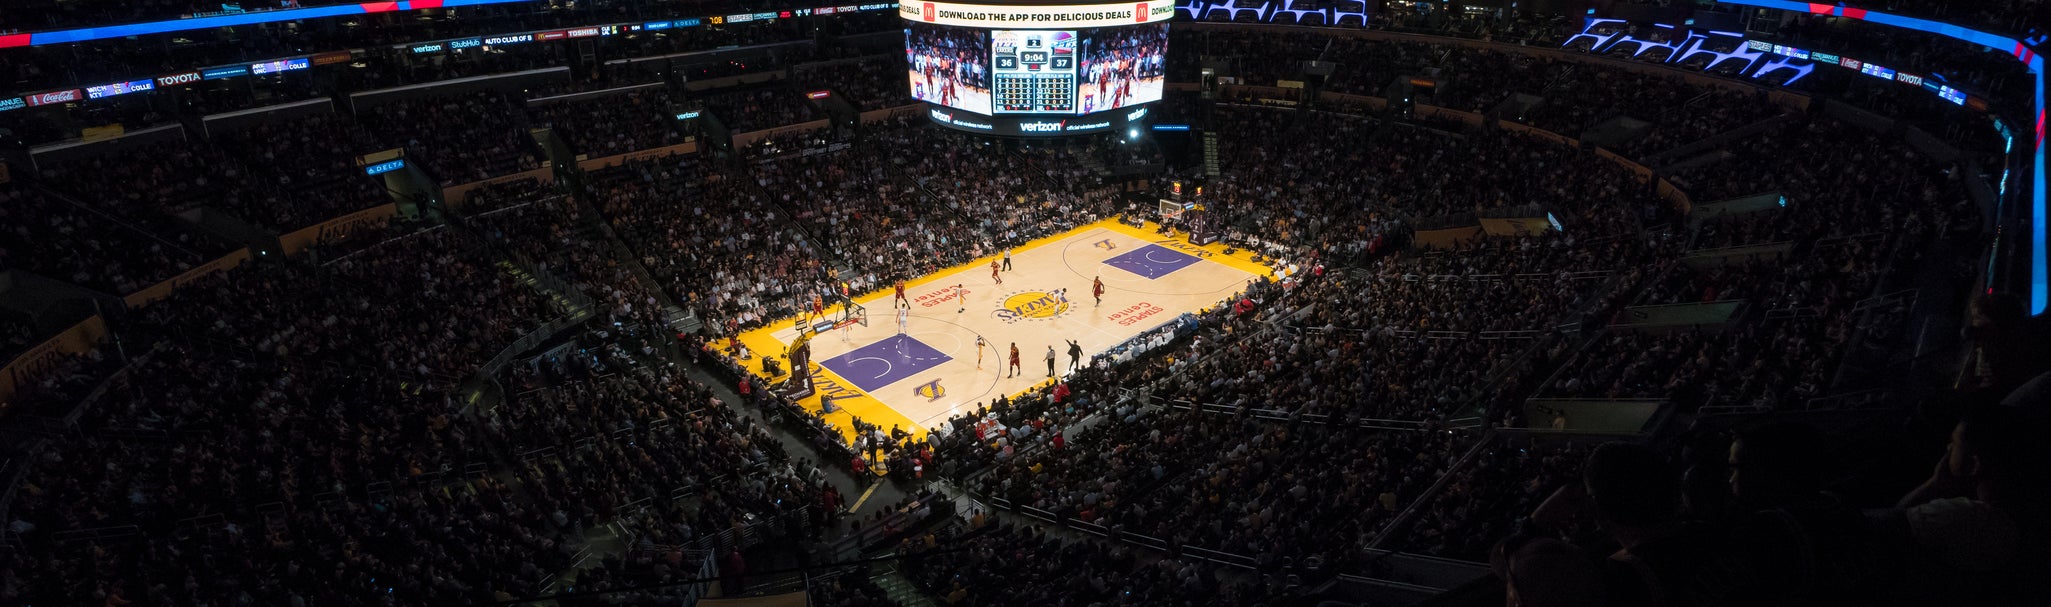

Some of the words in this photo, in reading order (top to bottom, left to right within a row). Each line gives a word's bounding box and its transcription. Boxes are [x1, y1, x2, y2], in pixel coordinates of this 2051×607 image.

[939, 10, 986, 20] DOWNLOAD
[988, 13, 1006, 21] THE
[1053, 12, 1103, 21] DELICIOUS
[1105, 10, 1131, 20] DEALS
[568, 28, 599, 37] TOSHIBA
[413, 44, 441, 53] verizon
[451, 39, 480, 48] StubHub
[158, 73, 201, 86] TOYOTA
[1897, 72, 1922, 86] TOYOTA
[677, 111, 699, 120] verizon
[1020, 121, 1061, 131] verizon
[376, 161, 403, 171] DELTA
[1107, 302, 1152, 321] Center
[1118, 306, 1164, 327] STAPLES
